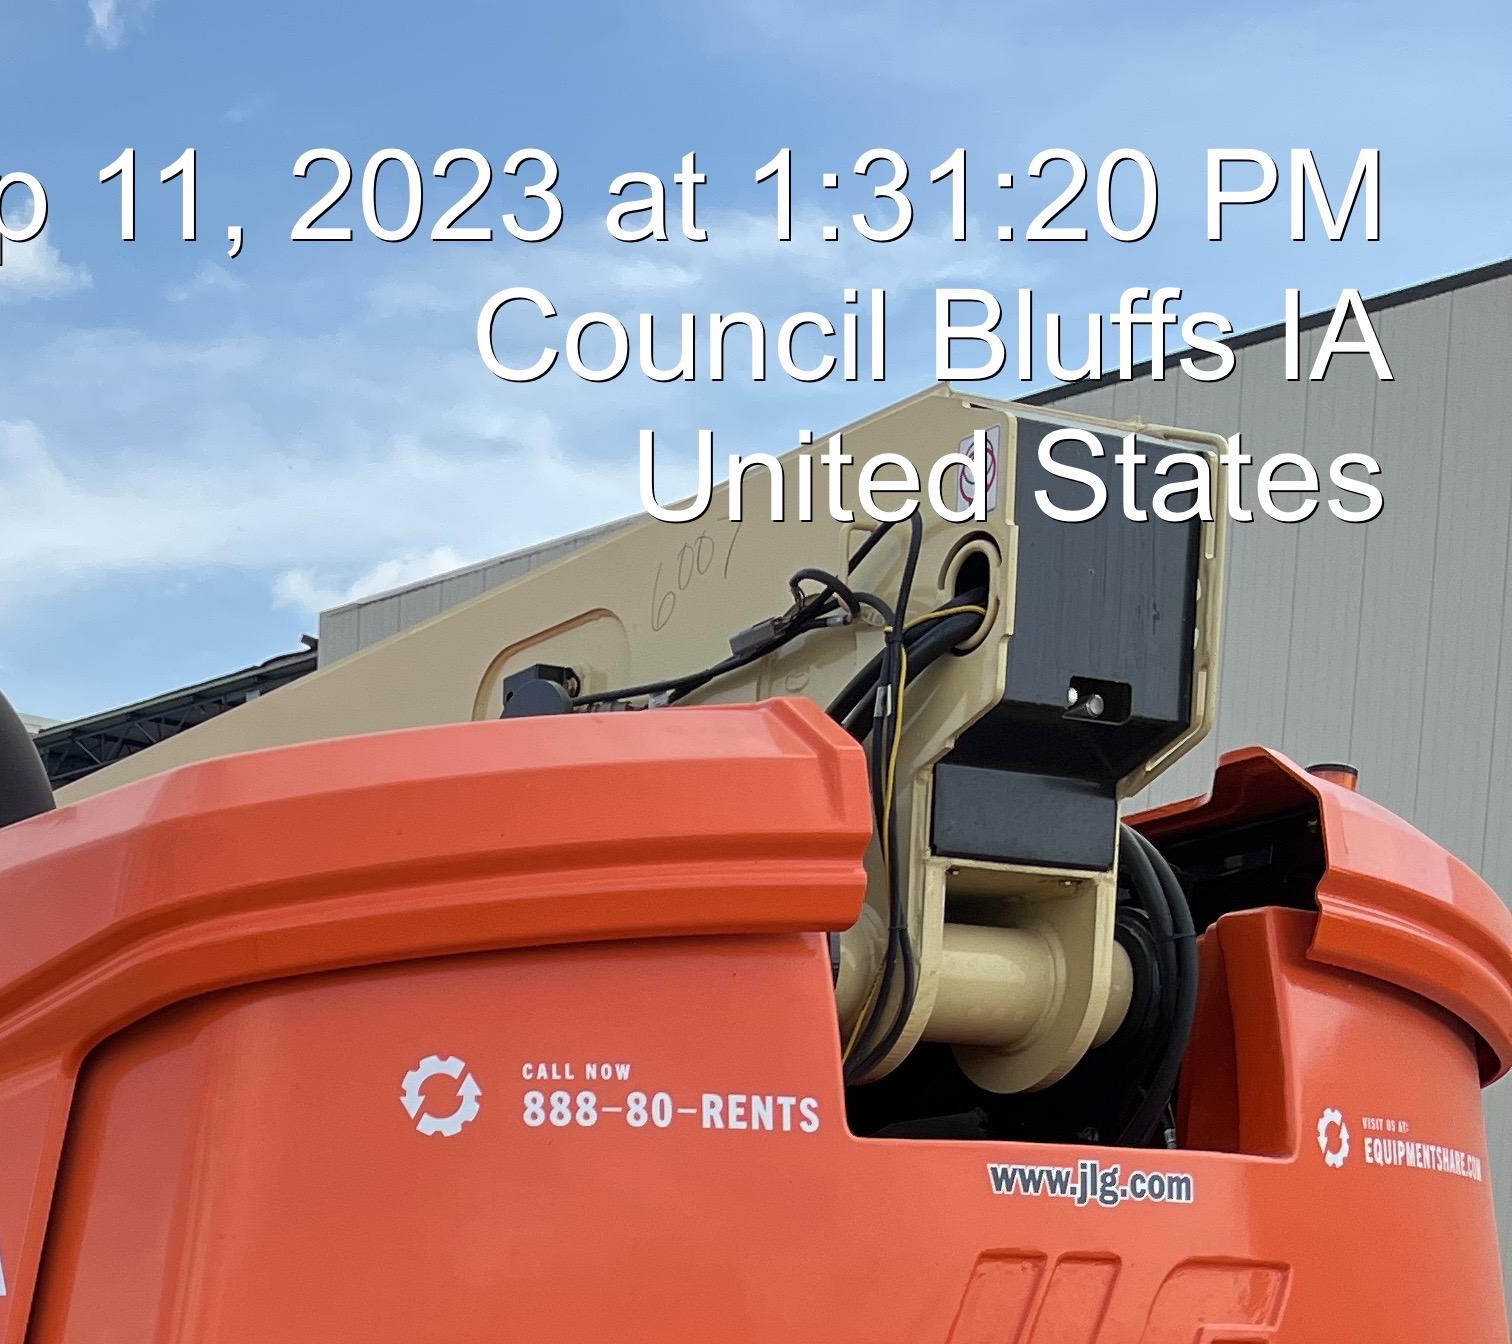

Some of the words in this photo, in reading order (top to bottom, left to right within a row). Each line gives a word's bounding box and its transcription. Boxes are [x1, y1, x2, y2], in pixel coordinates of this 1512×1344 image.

[522, 1063, 575, 1081] CALL
[585, 1063, 632, 1081] NOW
[522, 1090, 820, 1133] 888-80-RENTS
[1362, 1117, 1384, 1131] VISIT
[1386, 1119, 1396, 1132] US
[1364, 1137, 1482, 1182] EQUIPMENTSHARE.COM
[989, 1161, 1193, 1206] www.jlg.com
